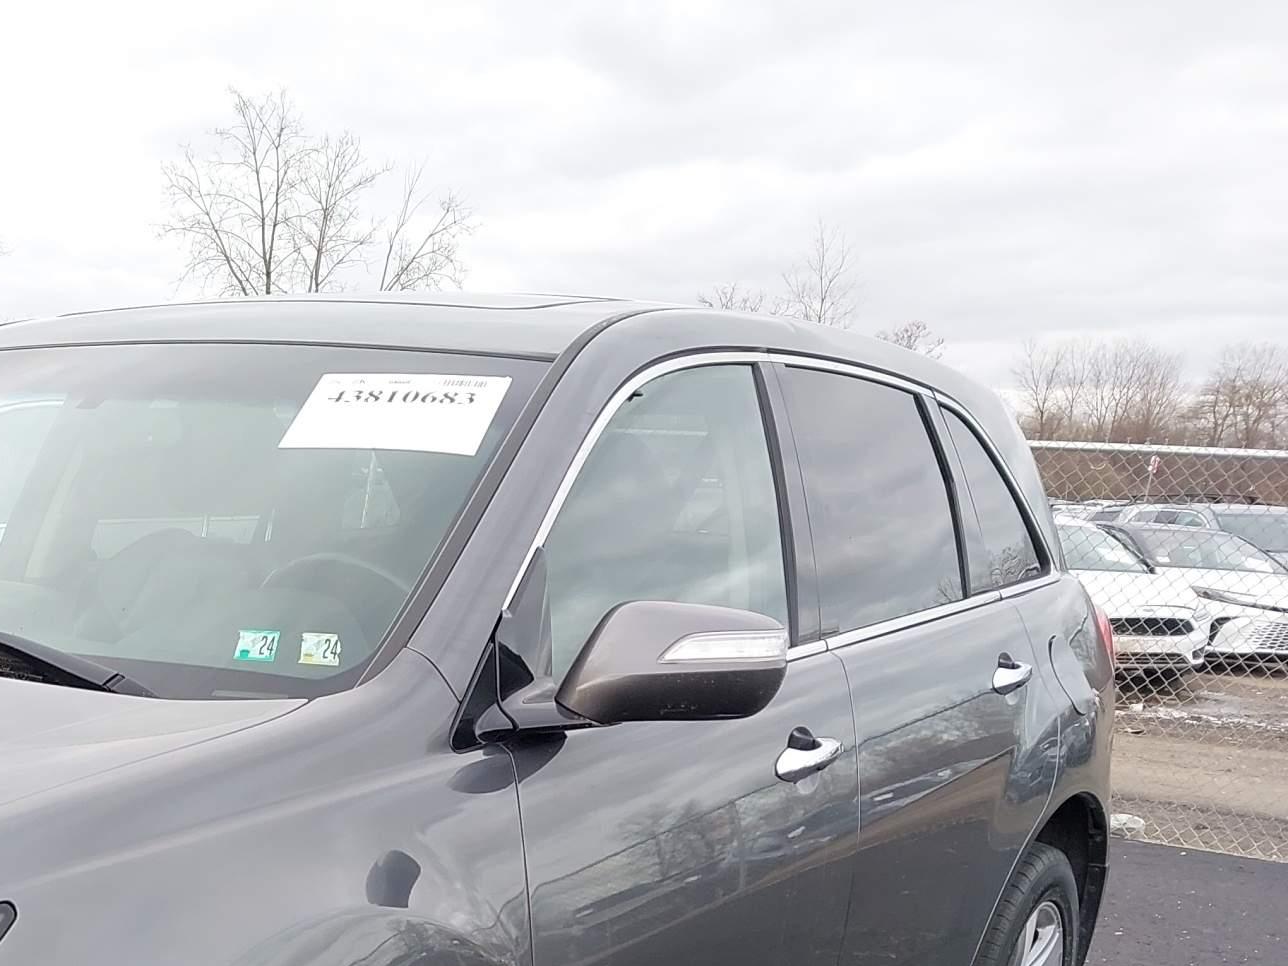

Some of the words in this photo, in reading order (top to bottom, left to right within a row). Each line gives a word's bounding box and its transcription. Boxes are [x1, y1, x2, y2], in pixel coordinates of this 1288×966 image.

[328, 389, 477, 406] 43810683
[258, 635, 277, 656] 24
[322, 638, 339, 660] 24
